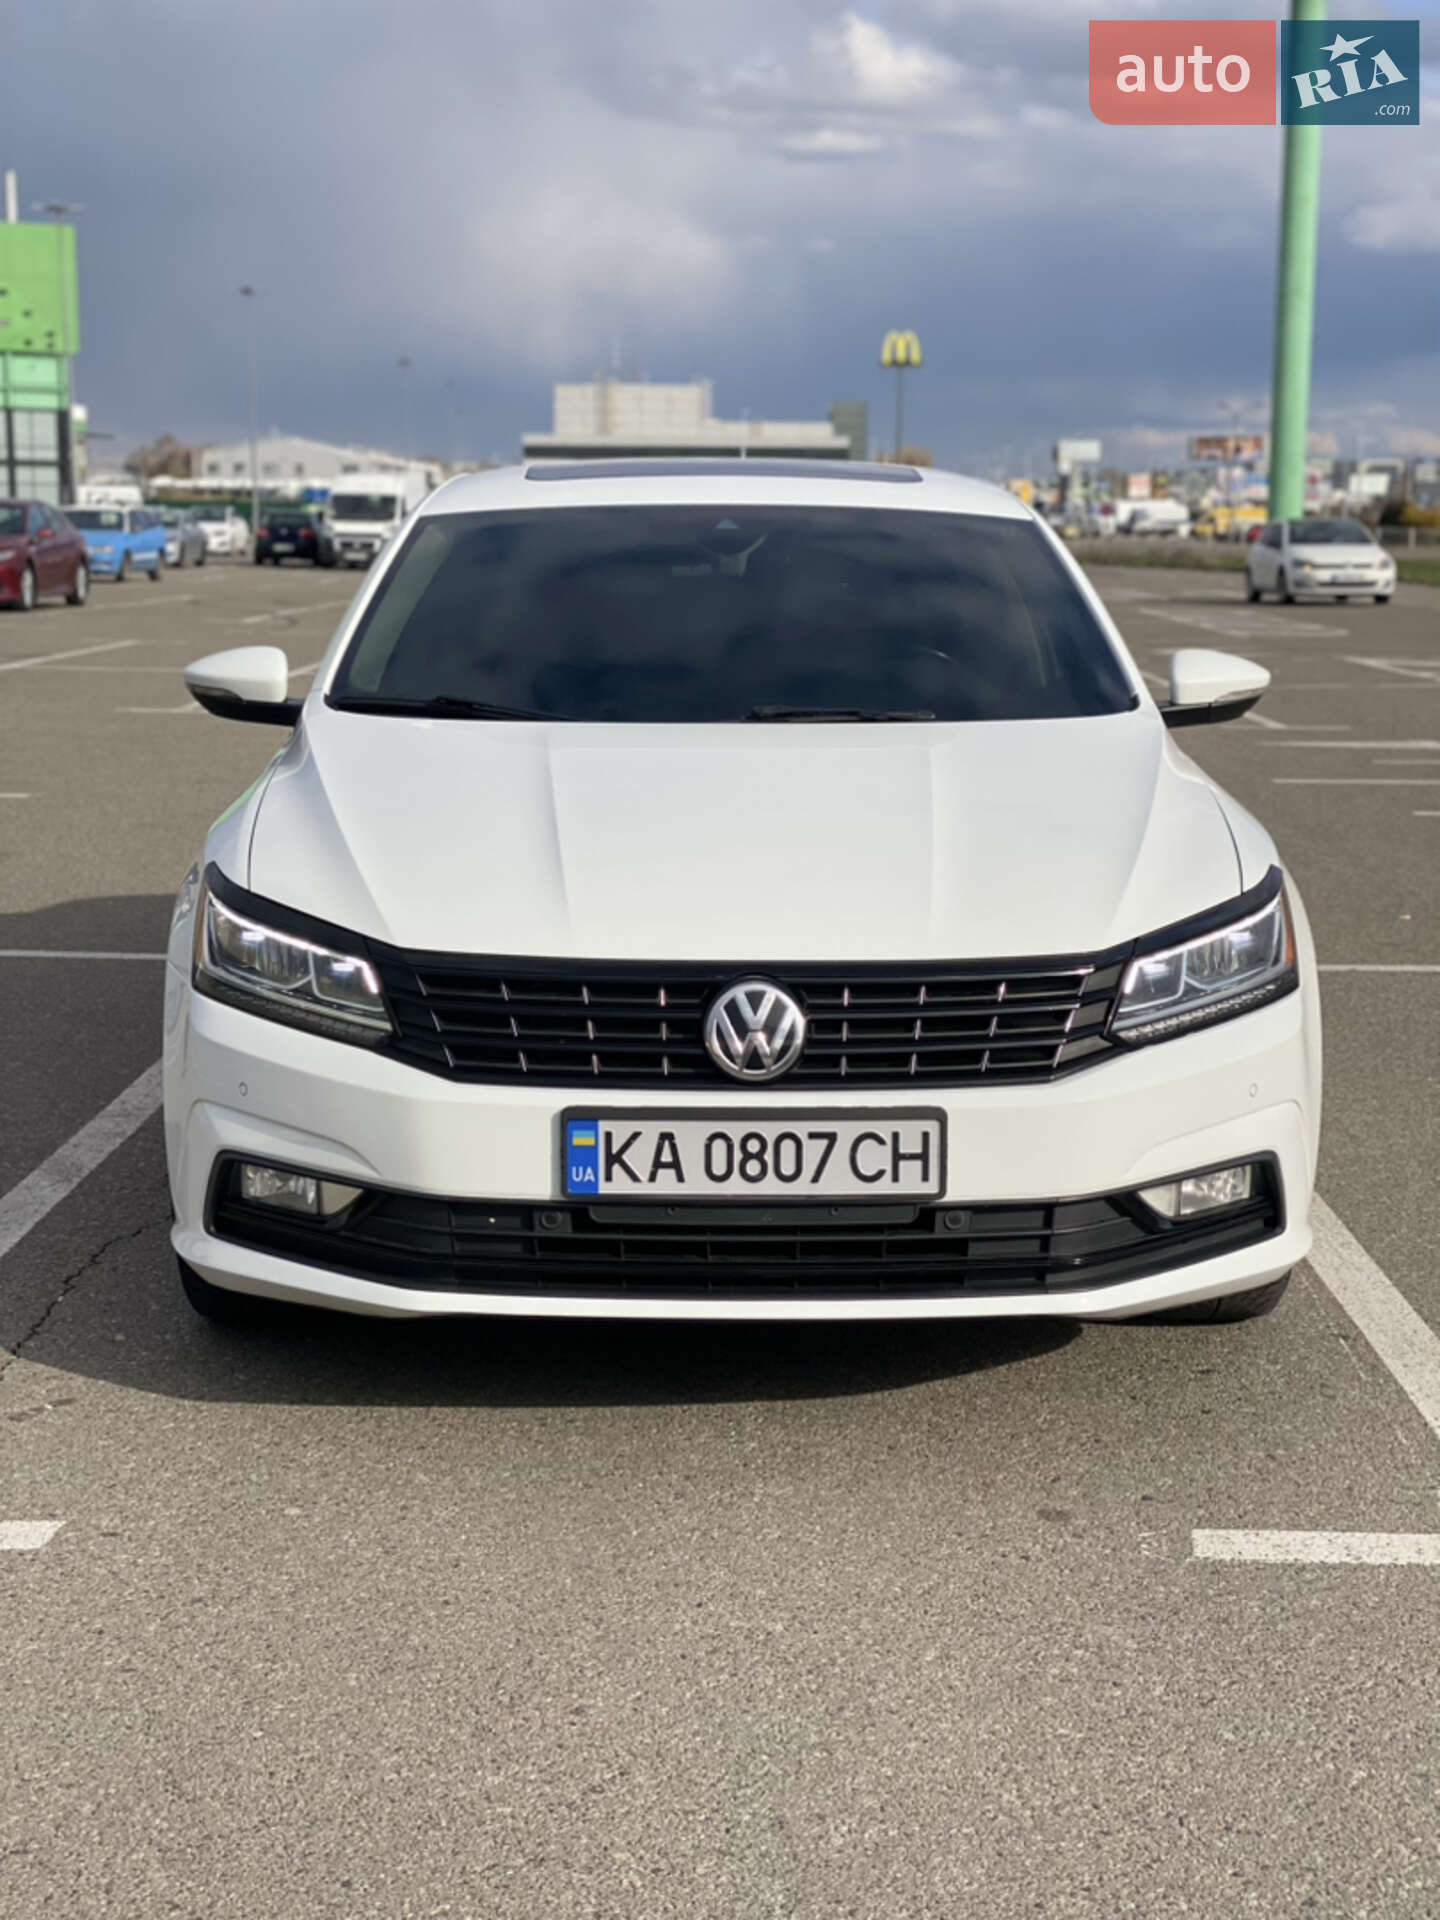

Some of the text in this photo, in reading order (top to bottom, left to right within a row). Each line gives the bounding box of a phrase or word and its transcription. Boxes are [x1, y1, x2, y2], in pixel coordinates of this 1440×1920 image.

[572, 1166, 595, 1183] UA
[604, 1131, 930, 1184] KA 0807 CH
